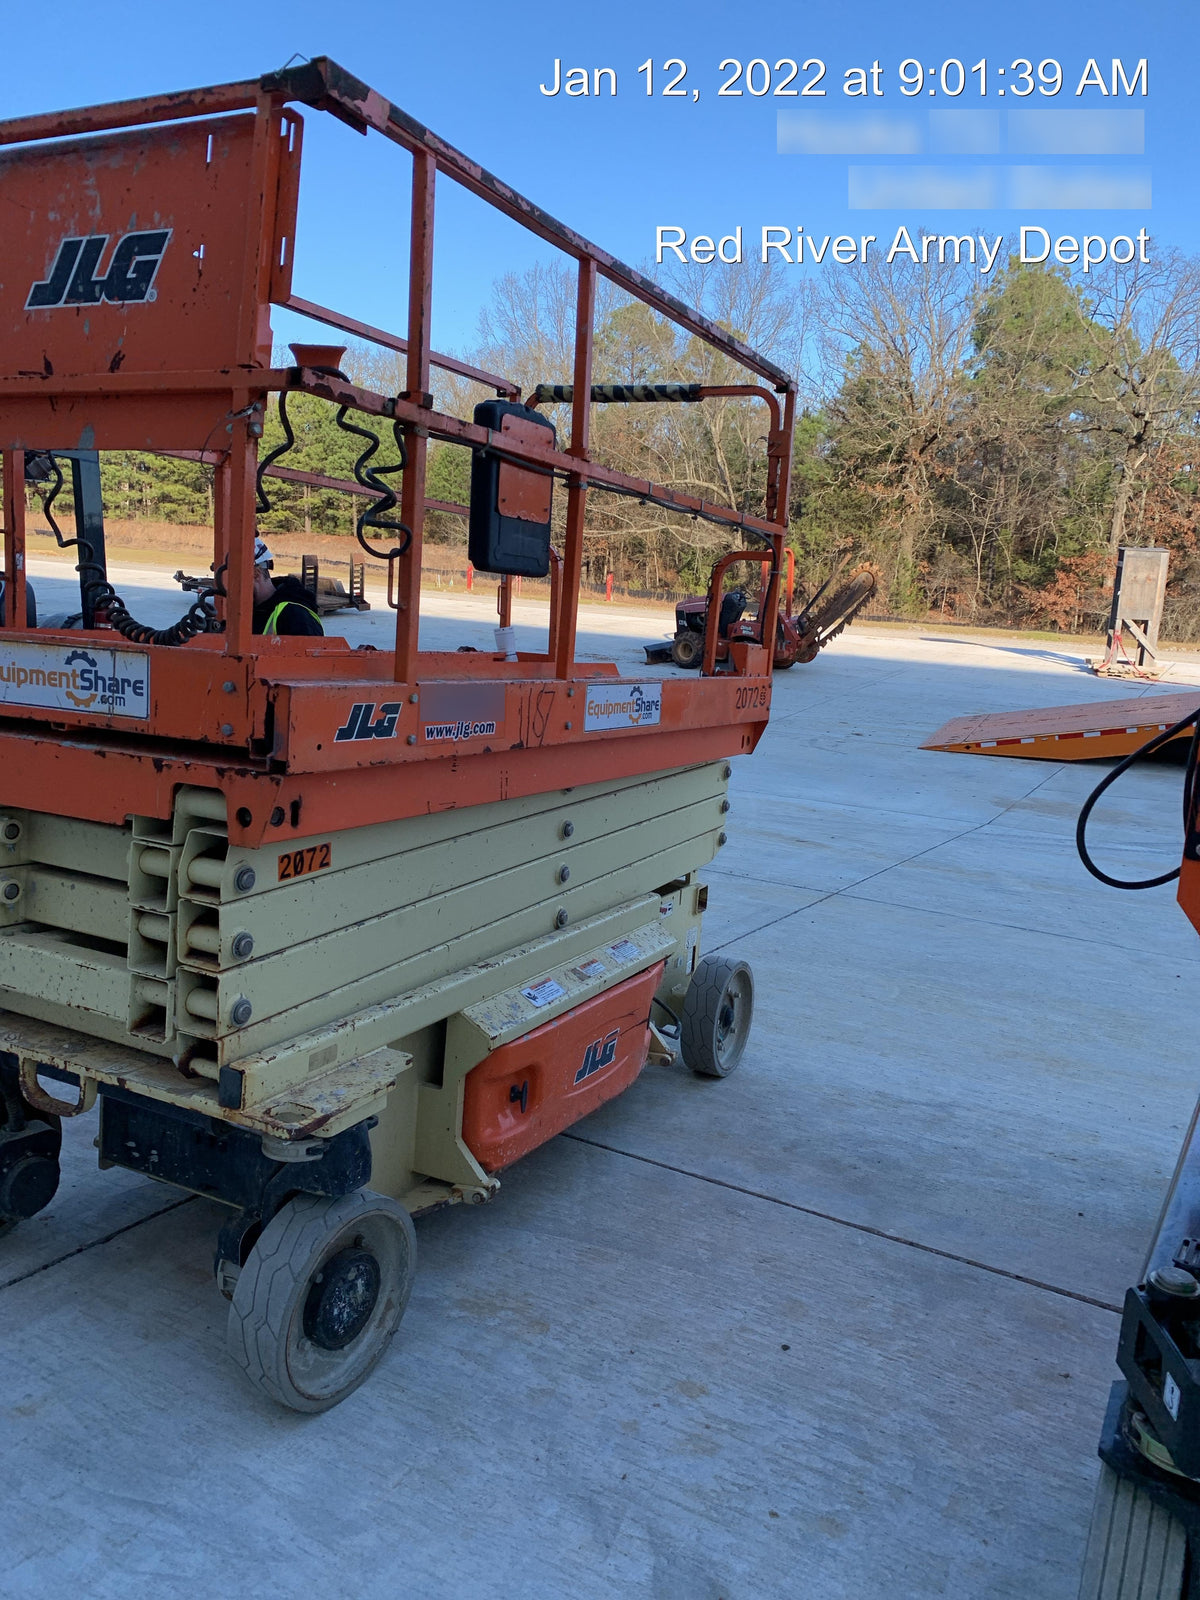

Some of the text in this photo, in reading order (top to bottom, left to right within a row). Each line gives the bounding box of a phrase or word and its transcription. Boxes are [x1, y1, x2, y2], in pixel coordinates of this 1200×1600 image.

[24, 228, 173, 310] JLG
[334, 702, 403, 742] JLG
[587, 697, 660, 719] EquipmentShare
[425, 721, 496, 741] www.jlg.com
[279, 843, 330, 880] 2072
[573, 1027, 620, 1086] JLG
